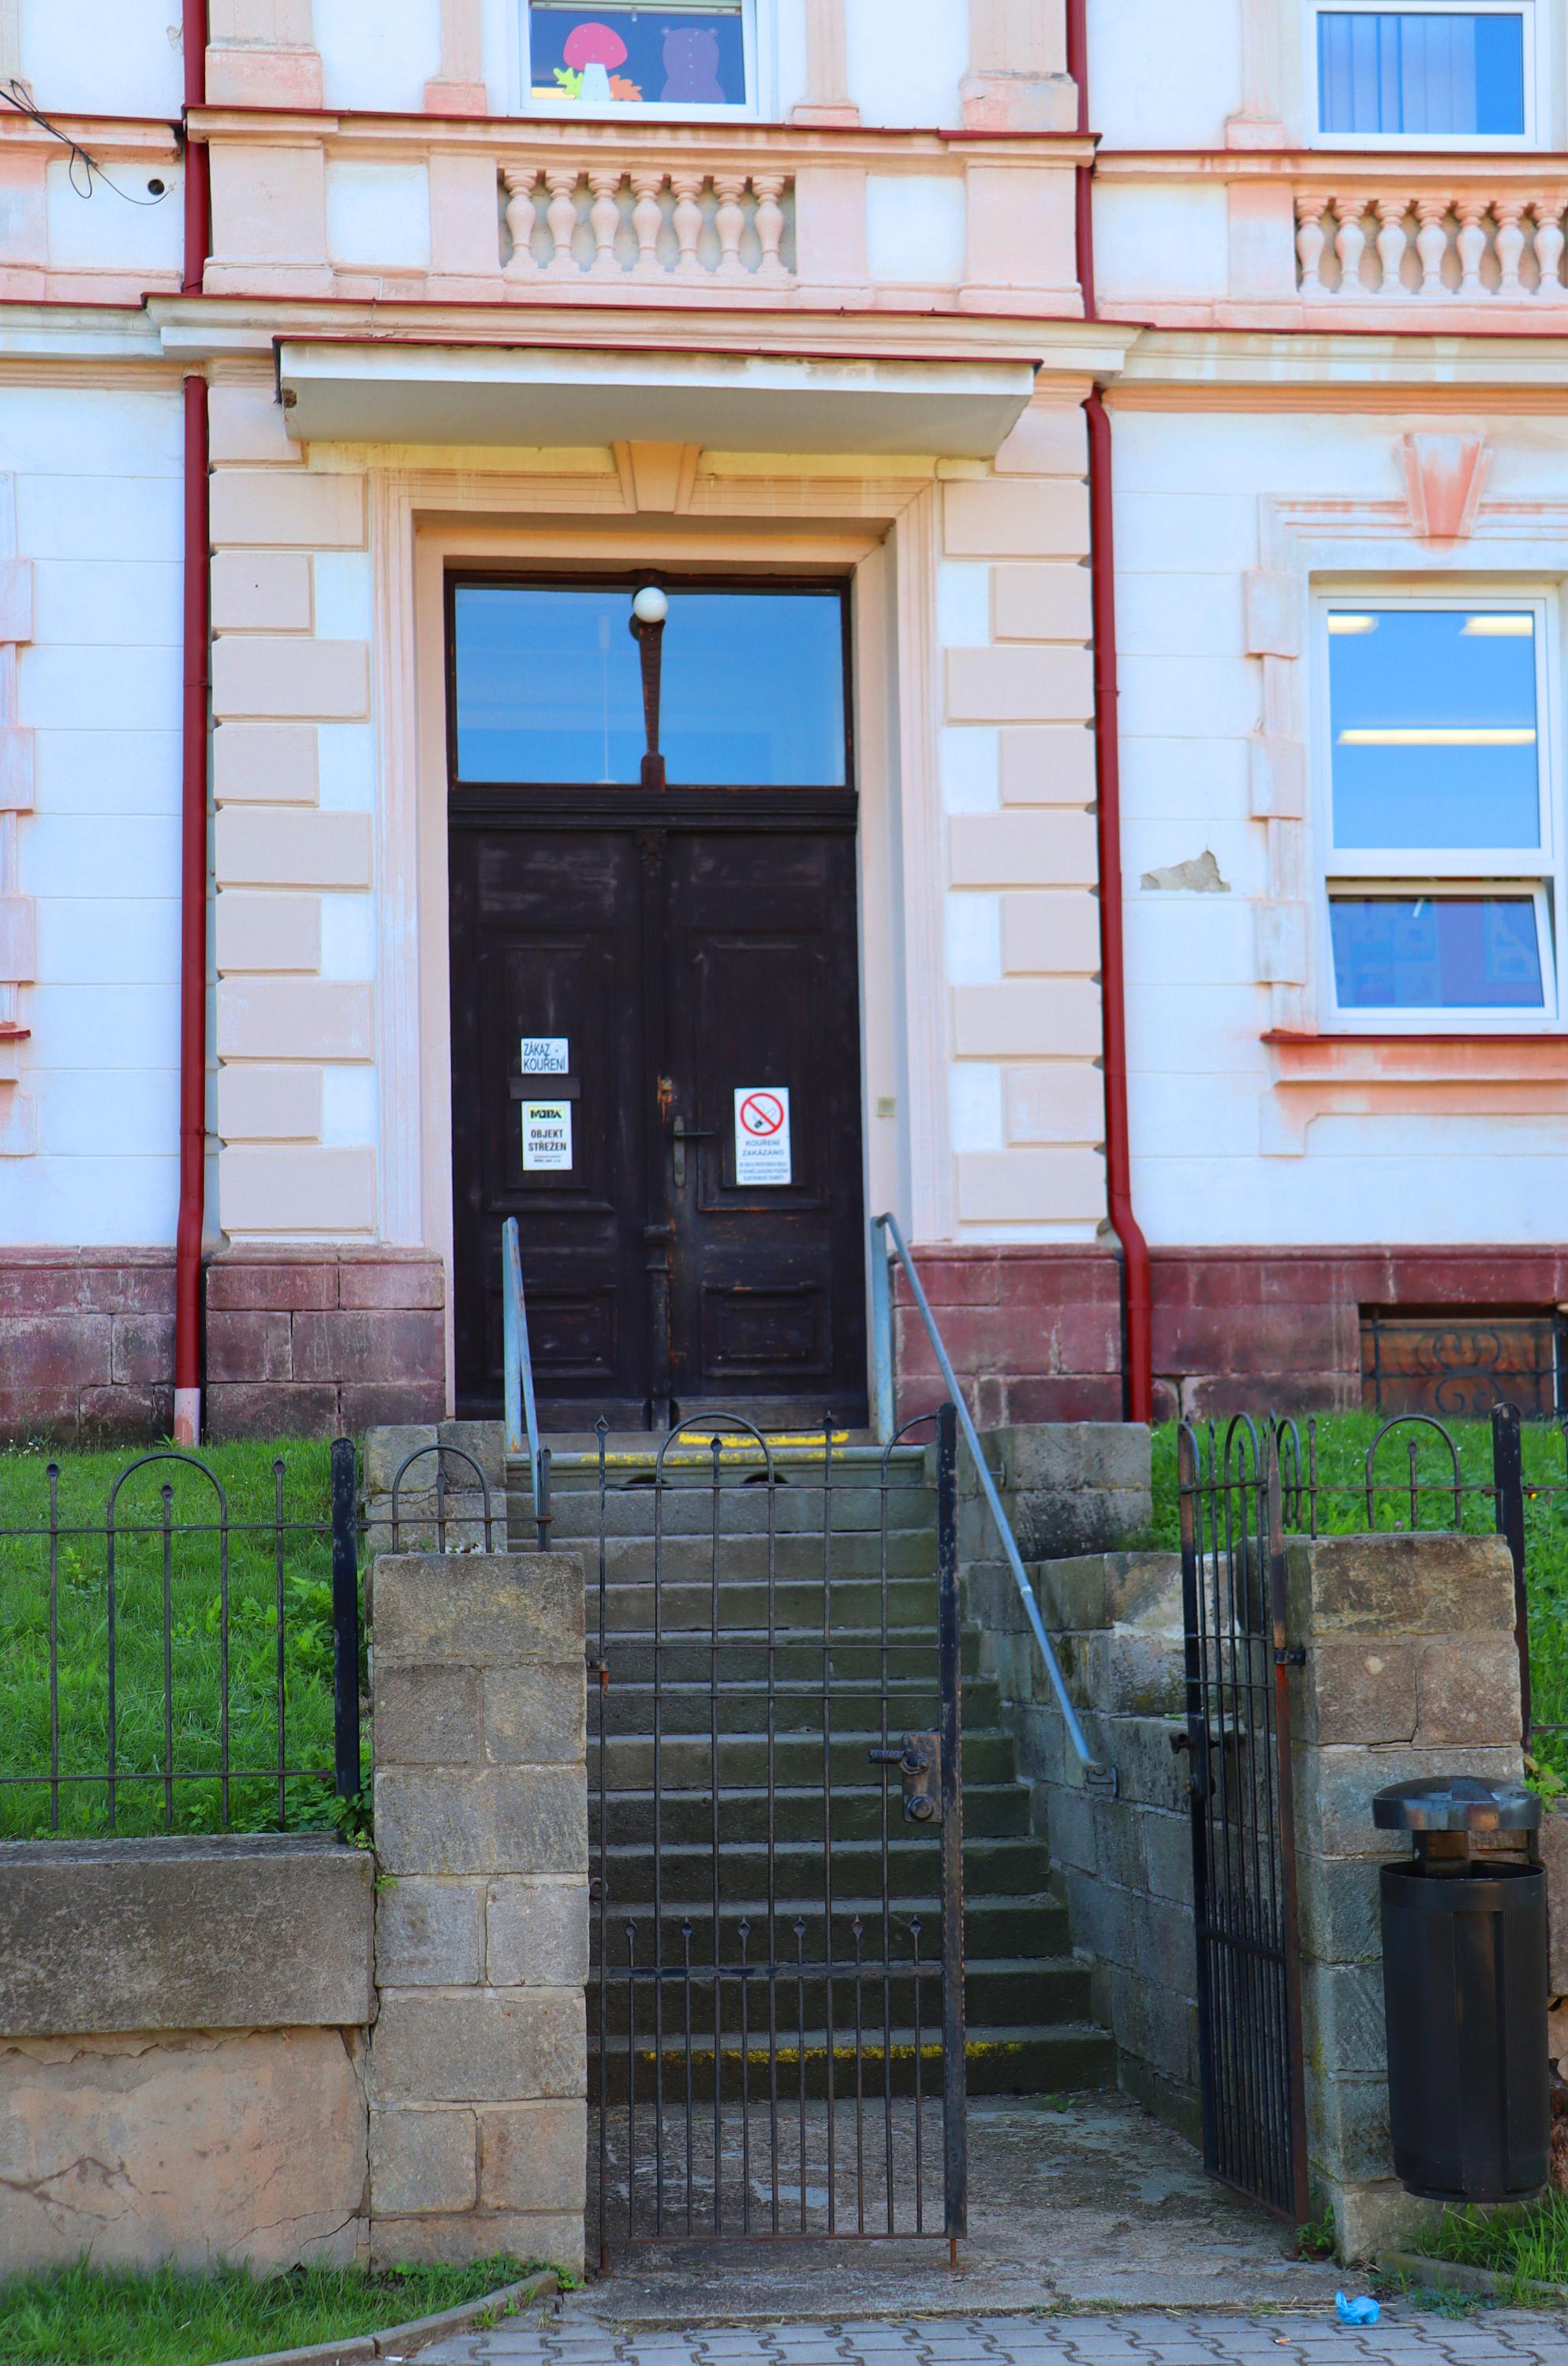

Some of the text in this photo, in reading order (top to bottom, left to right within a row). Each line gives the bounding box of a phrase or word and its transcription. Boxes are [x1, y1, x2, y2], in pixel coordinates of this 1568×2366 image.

[524, 1041, 551, 1057] ZÁKAZ
[531, 1129, 563, 1138] OBJEKT
[528, 1140, 566, 1151] STŘEŽEN
